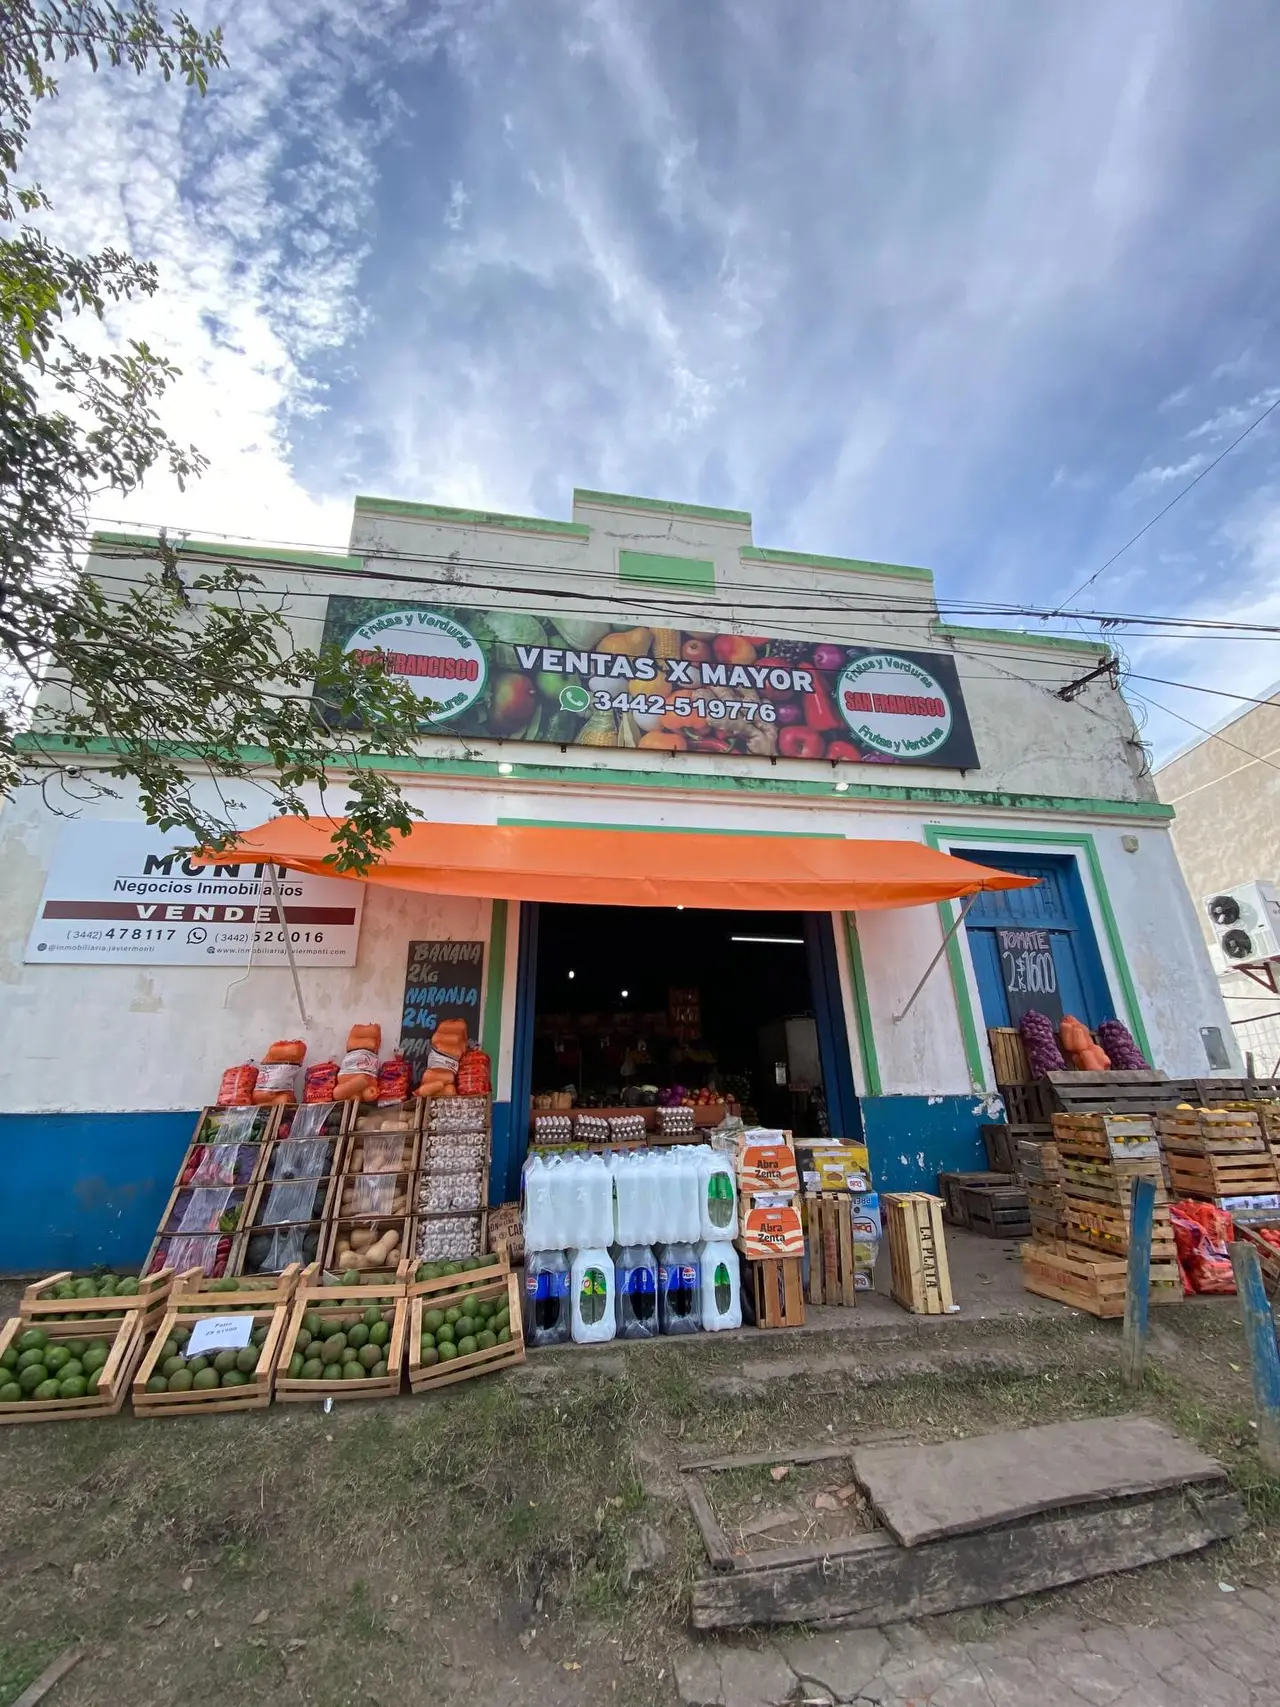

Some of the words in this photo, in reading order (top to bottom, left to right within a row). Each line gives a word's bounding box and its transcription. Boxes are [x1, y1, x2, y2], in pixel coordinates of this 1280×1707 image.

[358, 616, 403, 640] Frutas
[404, 614, 414, 627] y
[417, 612, 473, 649] Verduras
[514, 645, 656, 680] VENTAS
[667, 659, 693, 684] X
[700, 662, 814, 693] MAYOR
[845, 660, 876, 682] Frutas
[876, 657, 883, 670] y
[884, 657, 933, 689] Verduras
[593, 690, 778, 723] 3442-519776
[843, 690, 874, 712] SAN
[871, 693, 946, 718] FRANCISCO
[858, 724, 893, 748] Frutas
[893, 741, 901, 753] y
[901, 727, 944, 751] Verduras
[113, 879, 196, 896] Negocios
[136, 904, 274, 922] VENDE
[66, 930, 103, 941] (3442)
[105, 927, 177, 941] 478117
[214, 932, 249, 944] (3442)
[999, 930, 1051, 950] TOMATE
[414, 943, 480, 964] BANANA
[405, 986, 478, 1007] NARANJA
[757, 1159, 779, 1168] Abra
[754, 1169, 782, 1179] Zenta
[759, 1223, 783, 1232] Abra
[919, 1226, 932, 1241] LA
[757, 1233, 786, 1243] Zenta
[922, 1247, 938, 1288] PLATA
